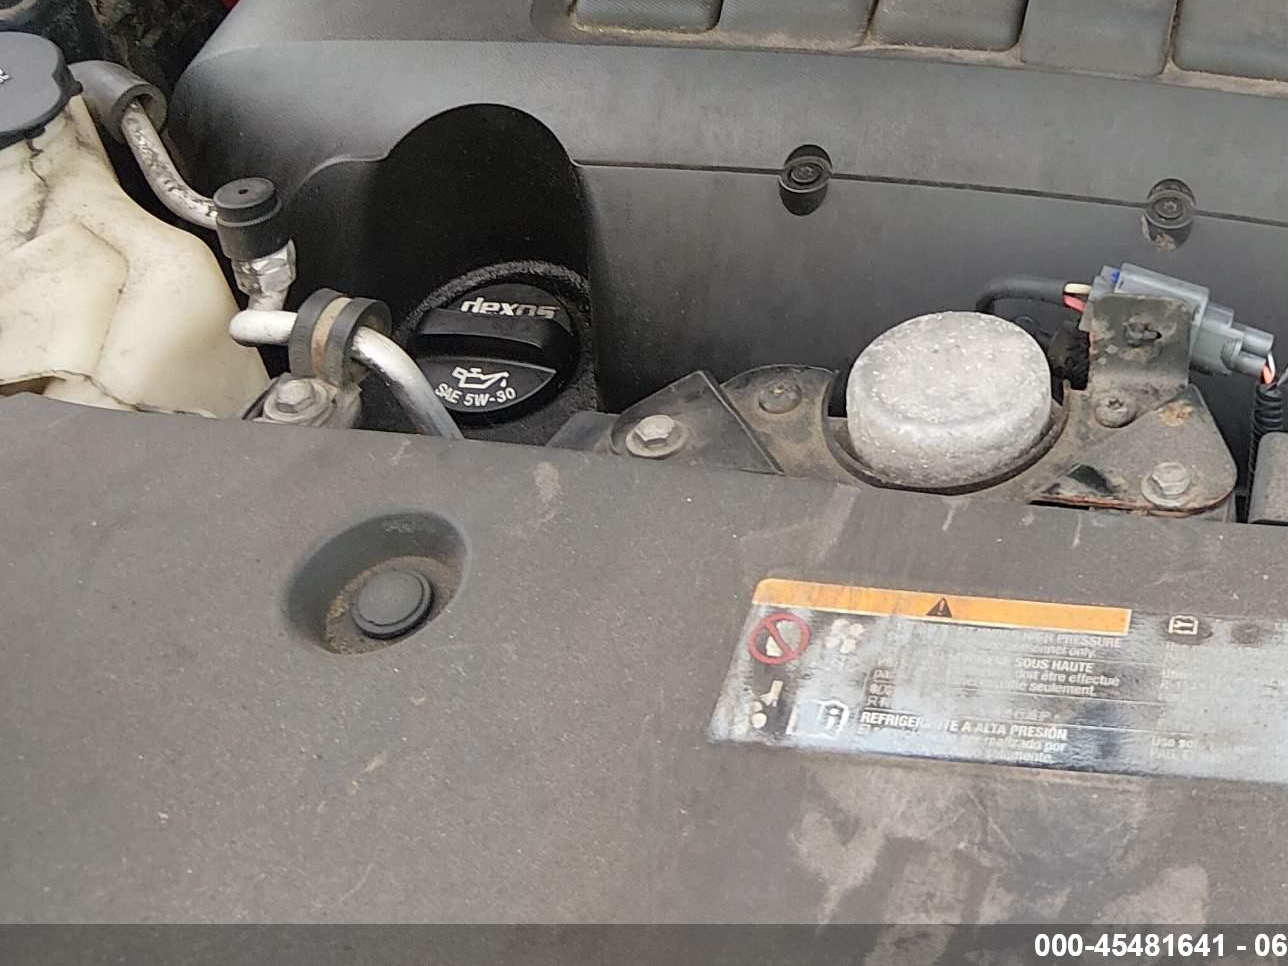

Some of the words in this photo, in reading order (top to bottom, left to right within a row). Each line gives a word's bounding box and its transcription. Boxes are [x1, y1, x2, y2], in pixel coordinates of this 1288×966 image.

[460, 297, 561, 320] dexos
[435, 383, 462, 404] SAE
[463, 387, 517, 406] 5W-30
[1056, 633, 1122, 648] PRESSURE
[1015, 657, 1050, 670] SOUS
[1052, 659, 1096, 673] HAUTE
[1041, 669, 1067, 682] être
[961, 720, 973, 732] A
[974, 722, 1007, 735] ALTA
[1009, 724, 1069, 741] PRESIÓN
